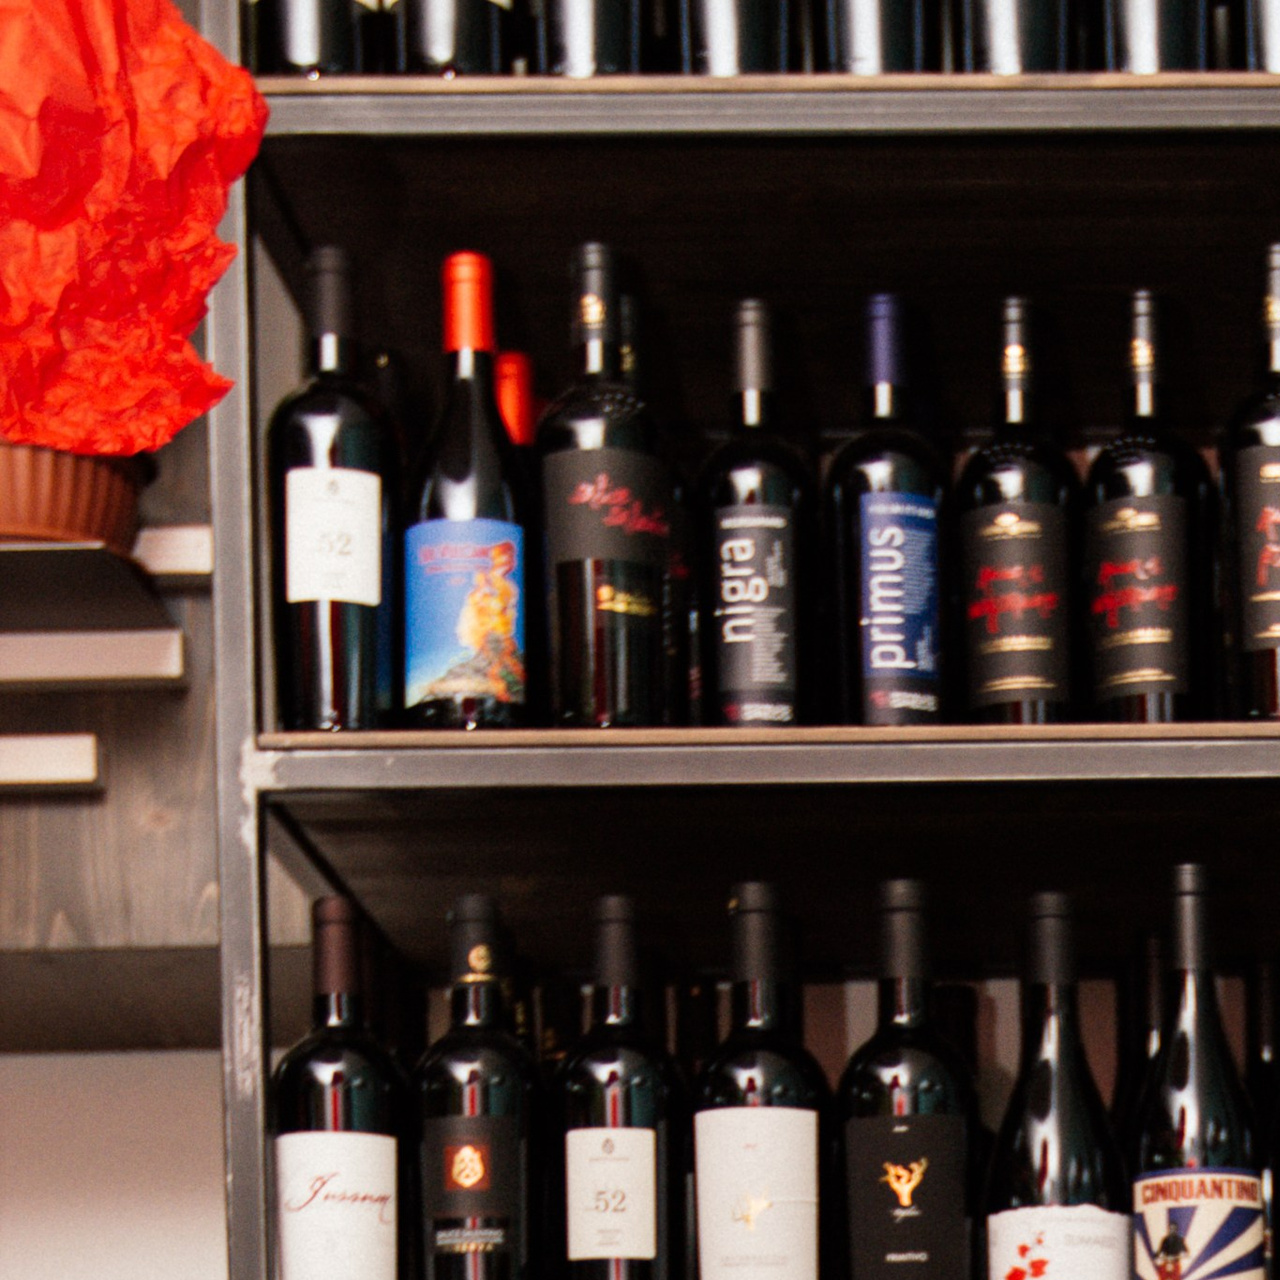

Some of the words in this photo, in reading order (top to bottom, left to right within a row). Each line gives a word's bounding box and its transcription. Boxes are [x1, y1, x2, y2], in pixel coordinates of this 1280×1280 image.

[713, 537, 769, 643] nigra
[859, 525, 918, 669] primus
[594, 1189, 627, 1213] 52
